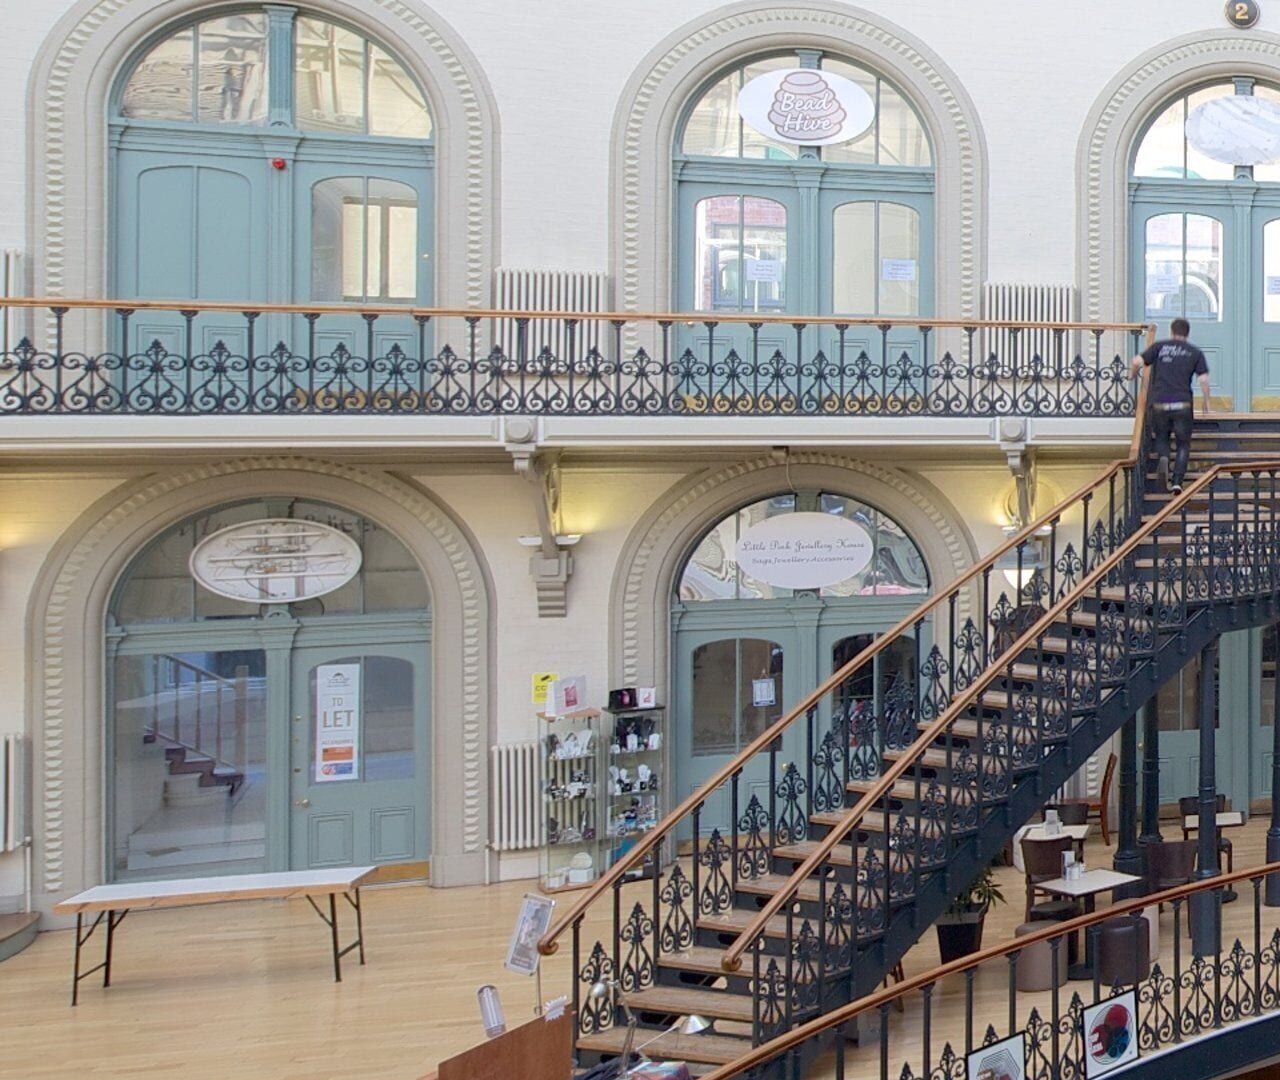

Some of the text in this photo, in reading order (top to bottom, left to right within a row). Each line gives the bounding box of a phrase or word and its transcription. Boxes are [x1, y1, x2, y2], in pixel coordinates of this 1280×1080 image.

[1235, 2, 1249, 19] 2
[781, 92, 831, 111] Bead
[783, 112, 833, 132] Hive
[741, 541, 766, 551] Little
[331, 697, 343, 707] TO
[323, 709, 354, 728] LET
